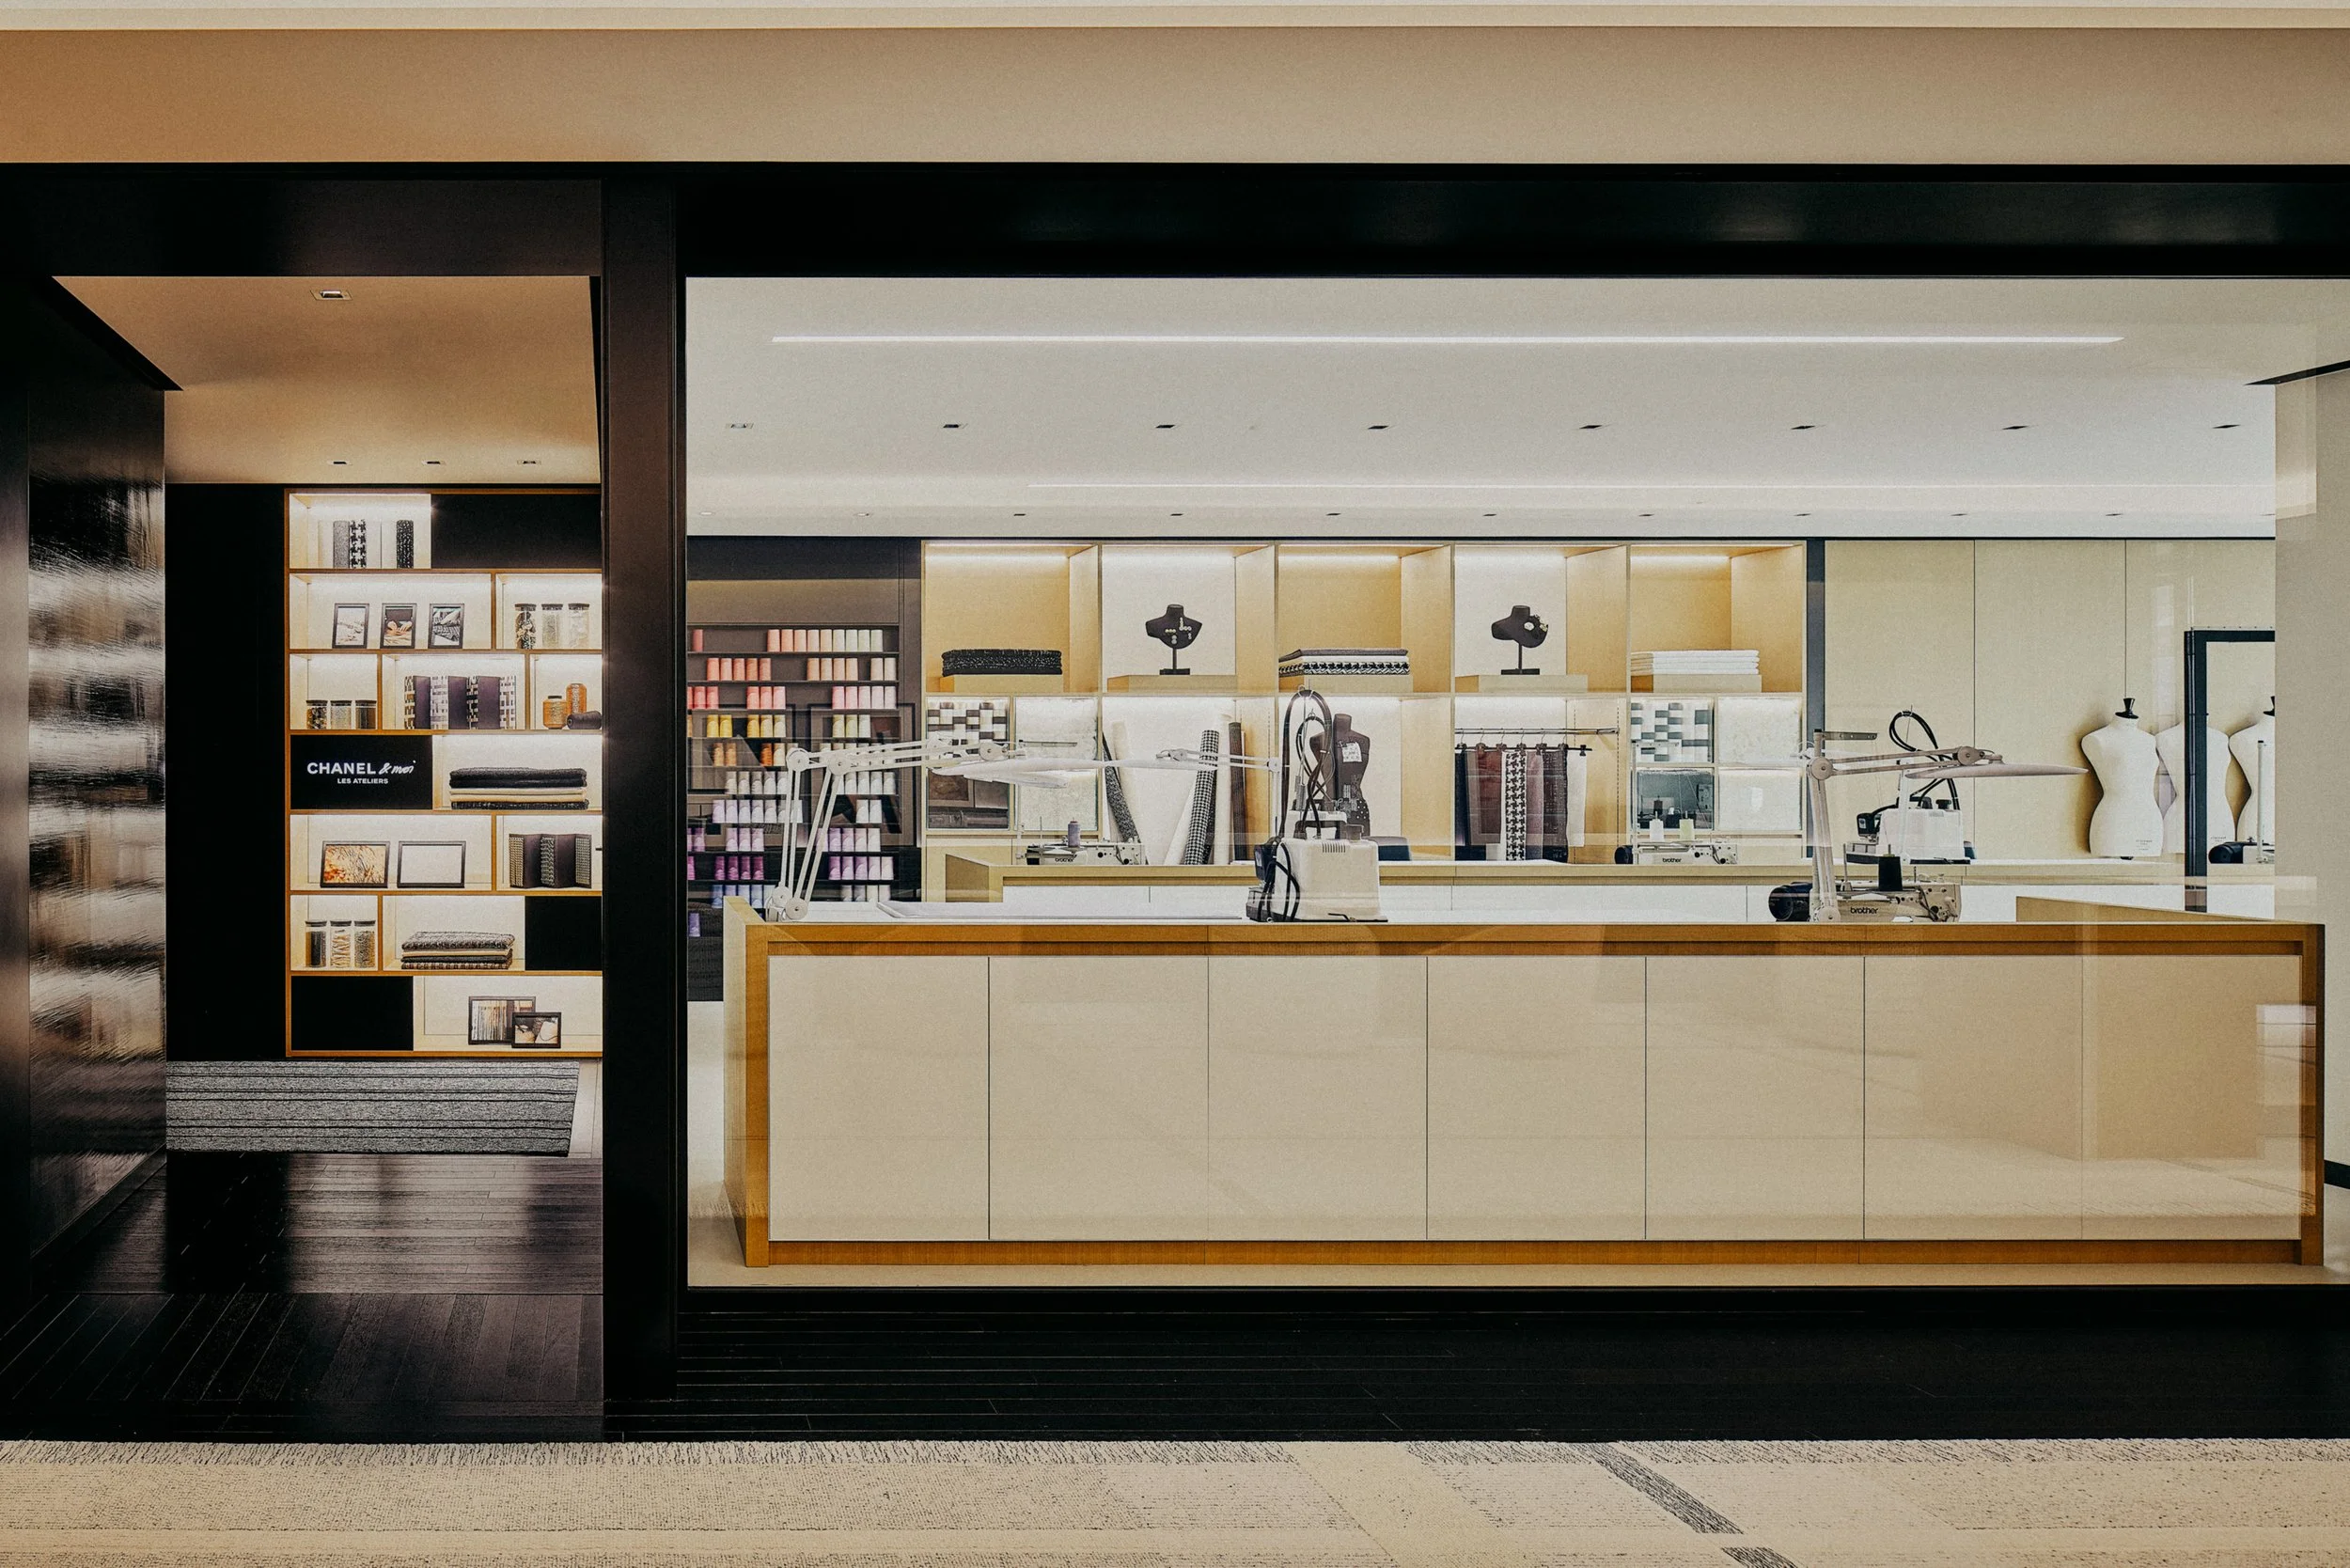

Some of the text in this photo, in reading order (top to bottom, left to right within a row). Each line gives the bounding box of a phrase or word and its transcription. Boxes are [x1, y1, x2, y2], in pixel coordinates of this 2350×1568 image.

[307, 760, 416, 775] CHANEL & moi
